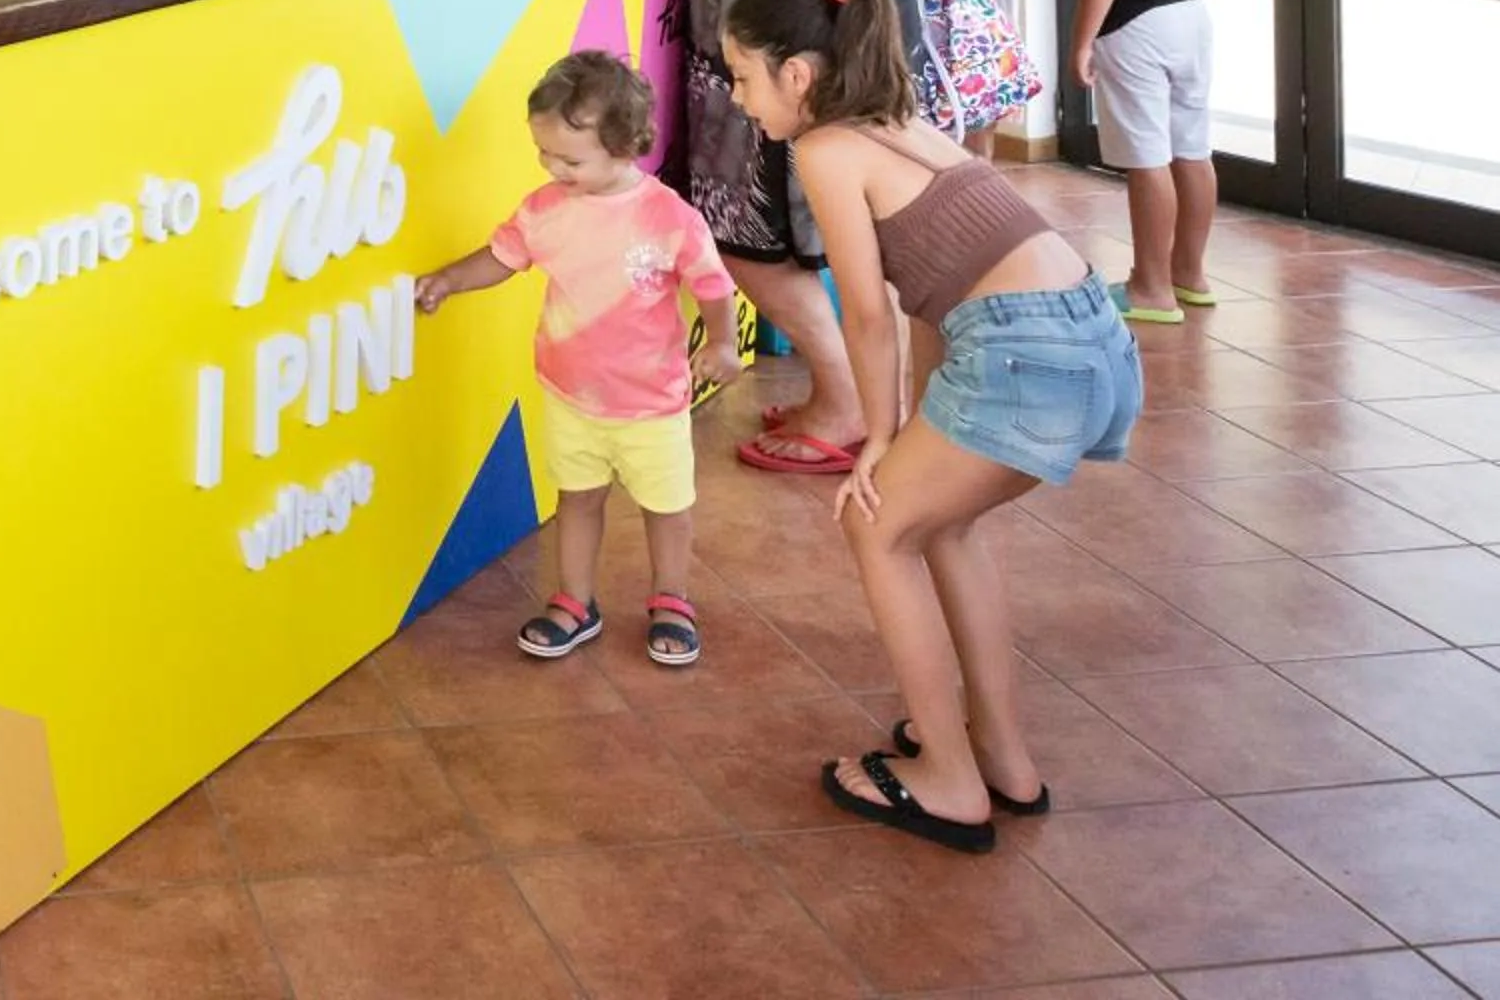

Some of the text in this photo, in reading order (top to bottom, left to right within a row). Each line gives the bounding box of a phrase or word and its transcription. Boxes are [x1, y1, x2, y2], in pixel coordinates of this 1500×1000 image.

[138, 174, 201, 244] to
[220, 64, 407, 308] hu
[195, 273, 416, 490] I PINI
[237, 460, 375, 571] village
